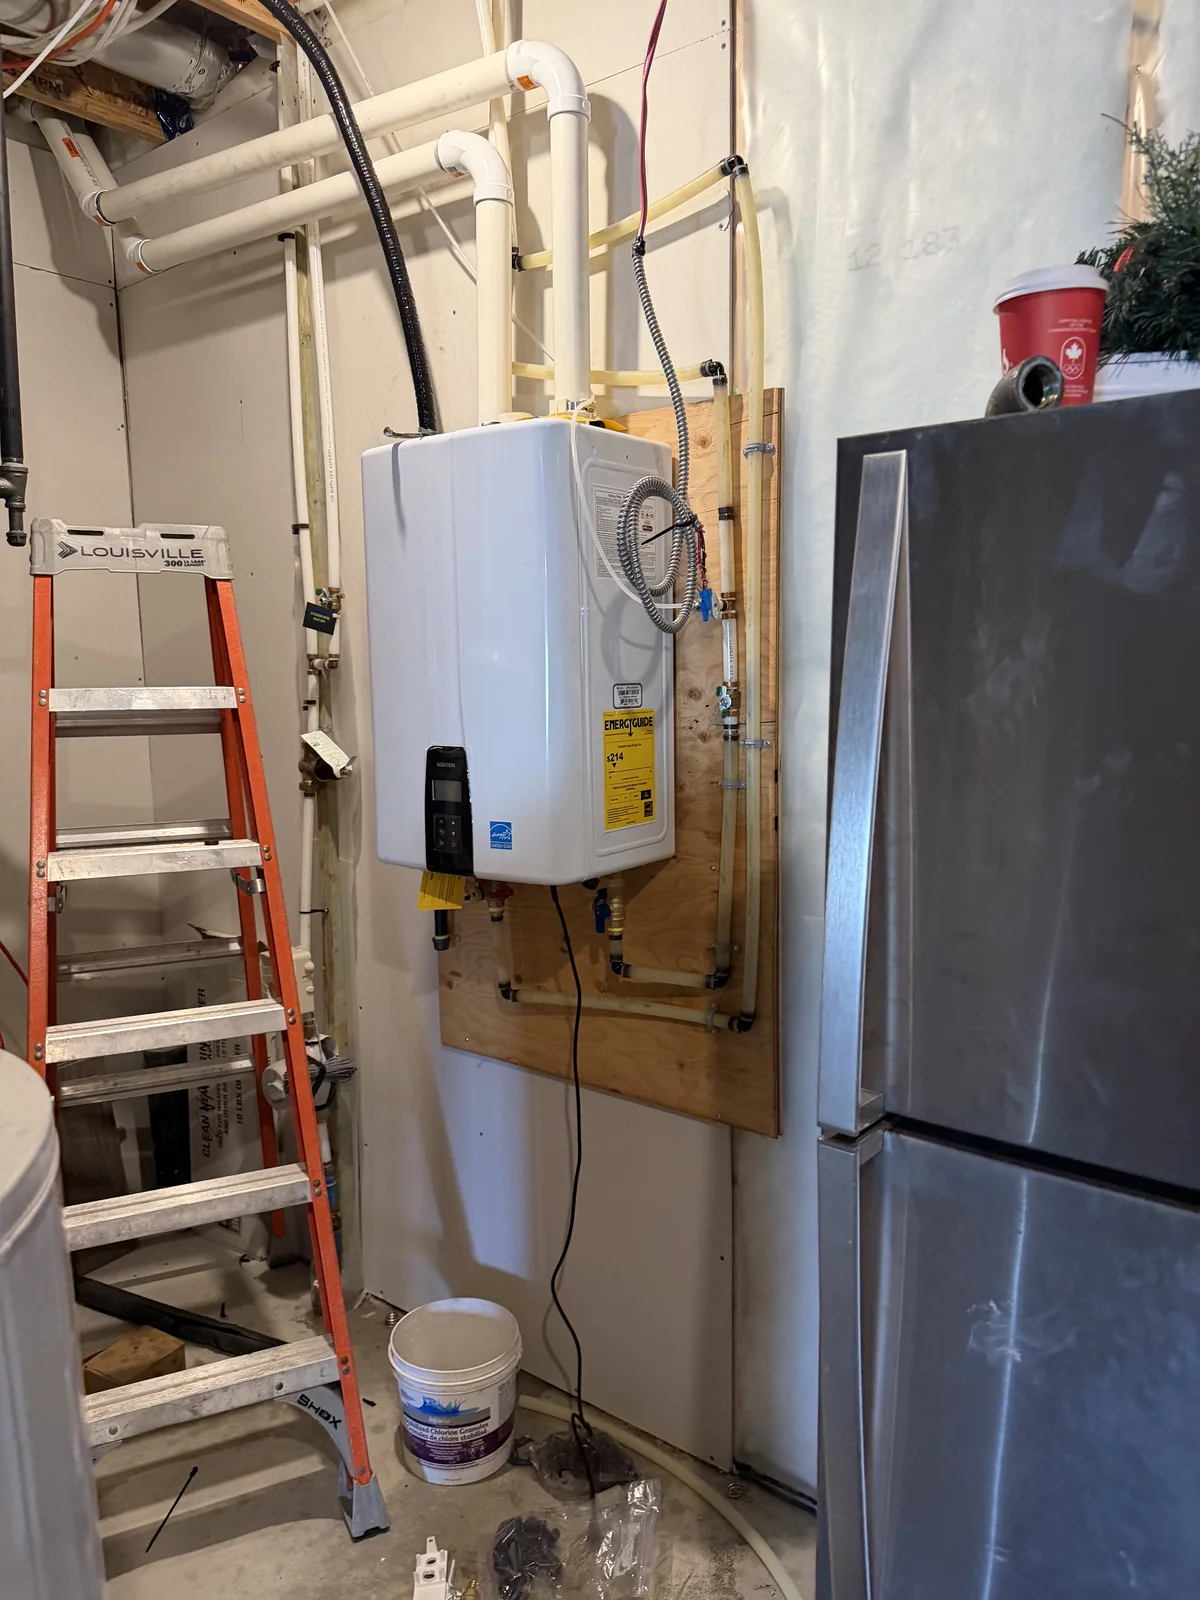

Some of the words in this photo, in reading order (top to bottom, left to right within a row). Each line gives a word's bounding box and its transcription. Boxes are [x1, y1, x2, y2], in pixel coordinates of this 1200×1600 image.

[80, 545, 204, 559] LOUISVILLE
[606, 752, 624, 763] $214
[200, 1115, 212, 1157] CLEAN
[297, 1393, 342, 1429] SHOX
[430, 1427, 458, 1435] Chlorine
[459, 1422, 489, 1435] Granules
